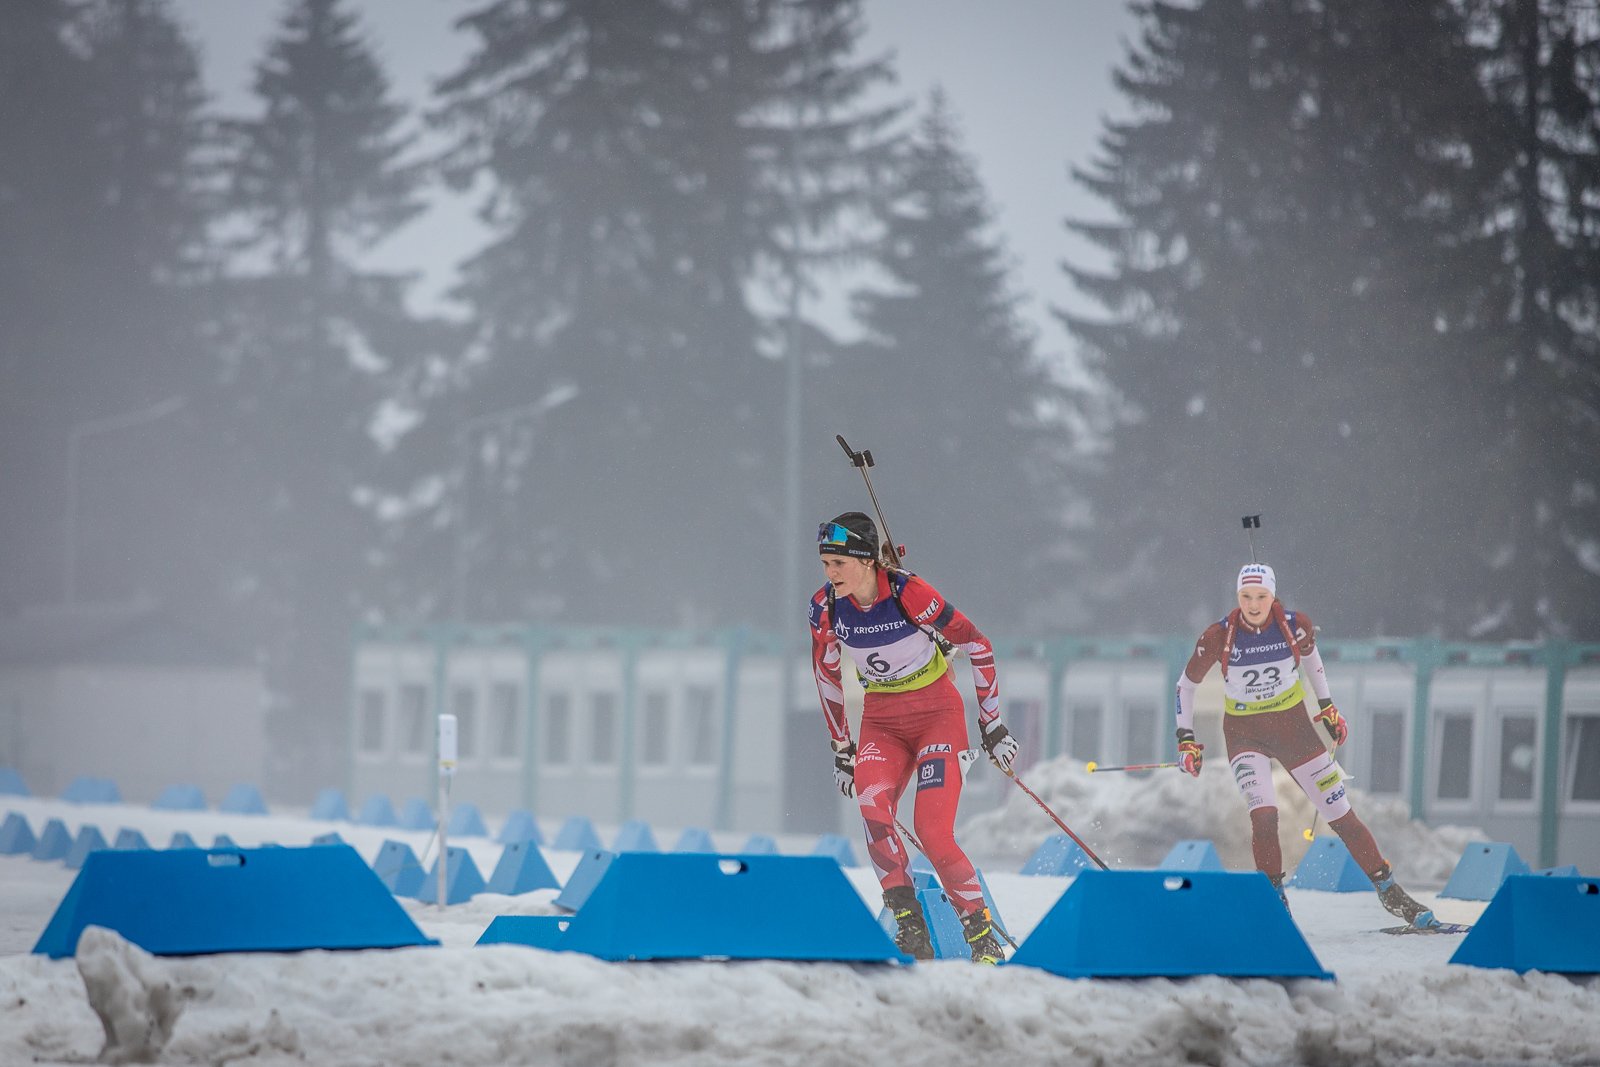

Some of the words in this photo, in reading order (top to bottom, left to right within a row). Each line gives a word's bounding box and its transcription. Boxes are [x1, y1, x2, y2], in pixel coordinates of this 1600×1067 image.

[1245, 642, 1289, 654] KRYOSYSTE
[866, 652, 891, 673] 6
[1242, 666, 1281, 687] 23
